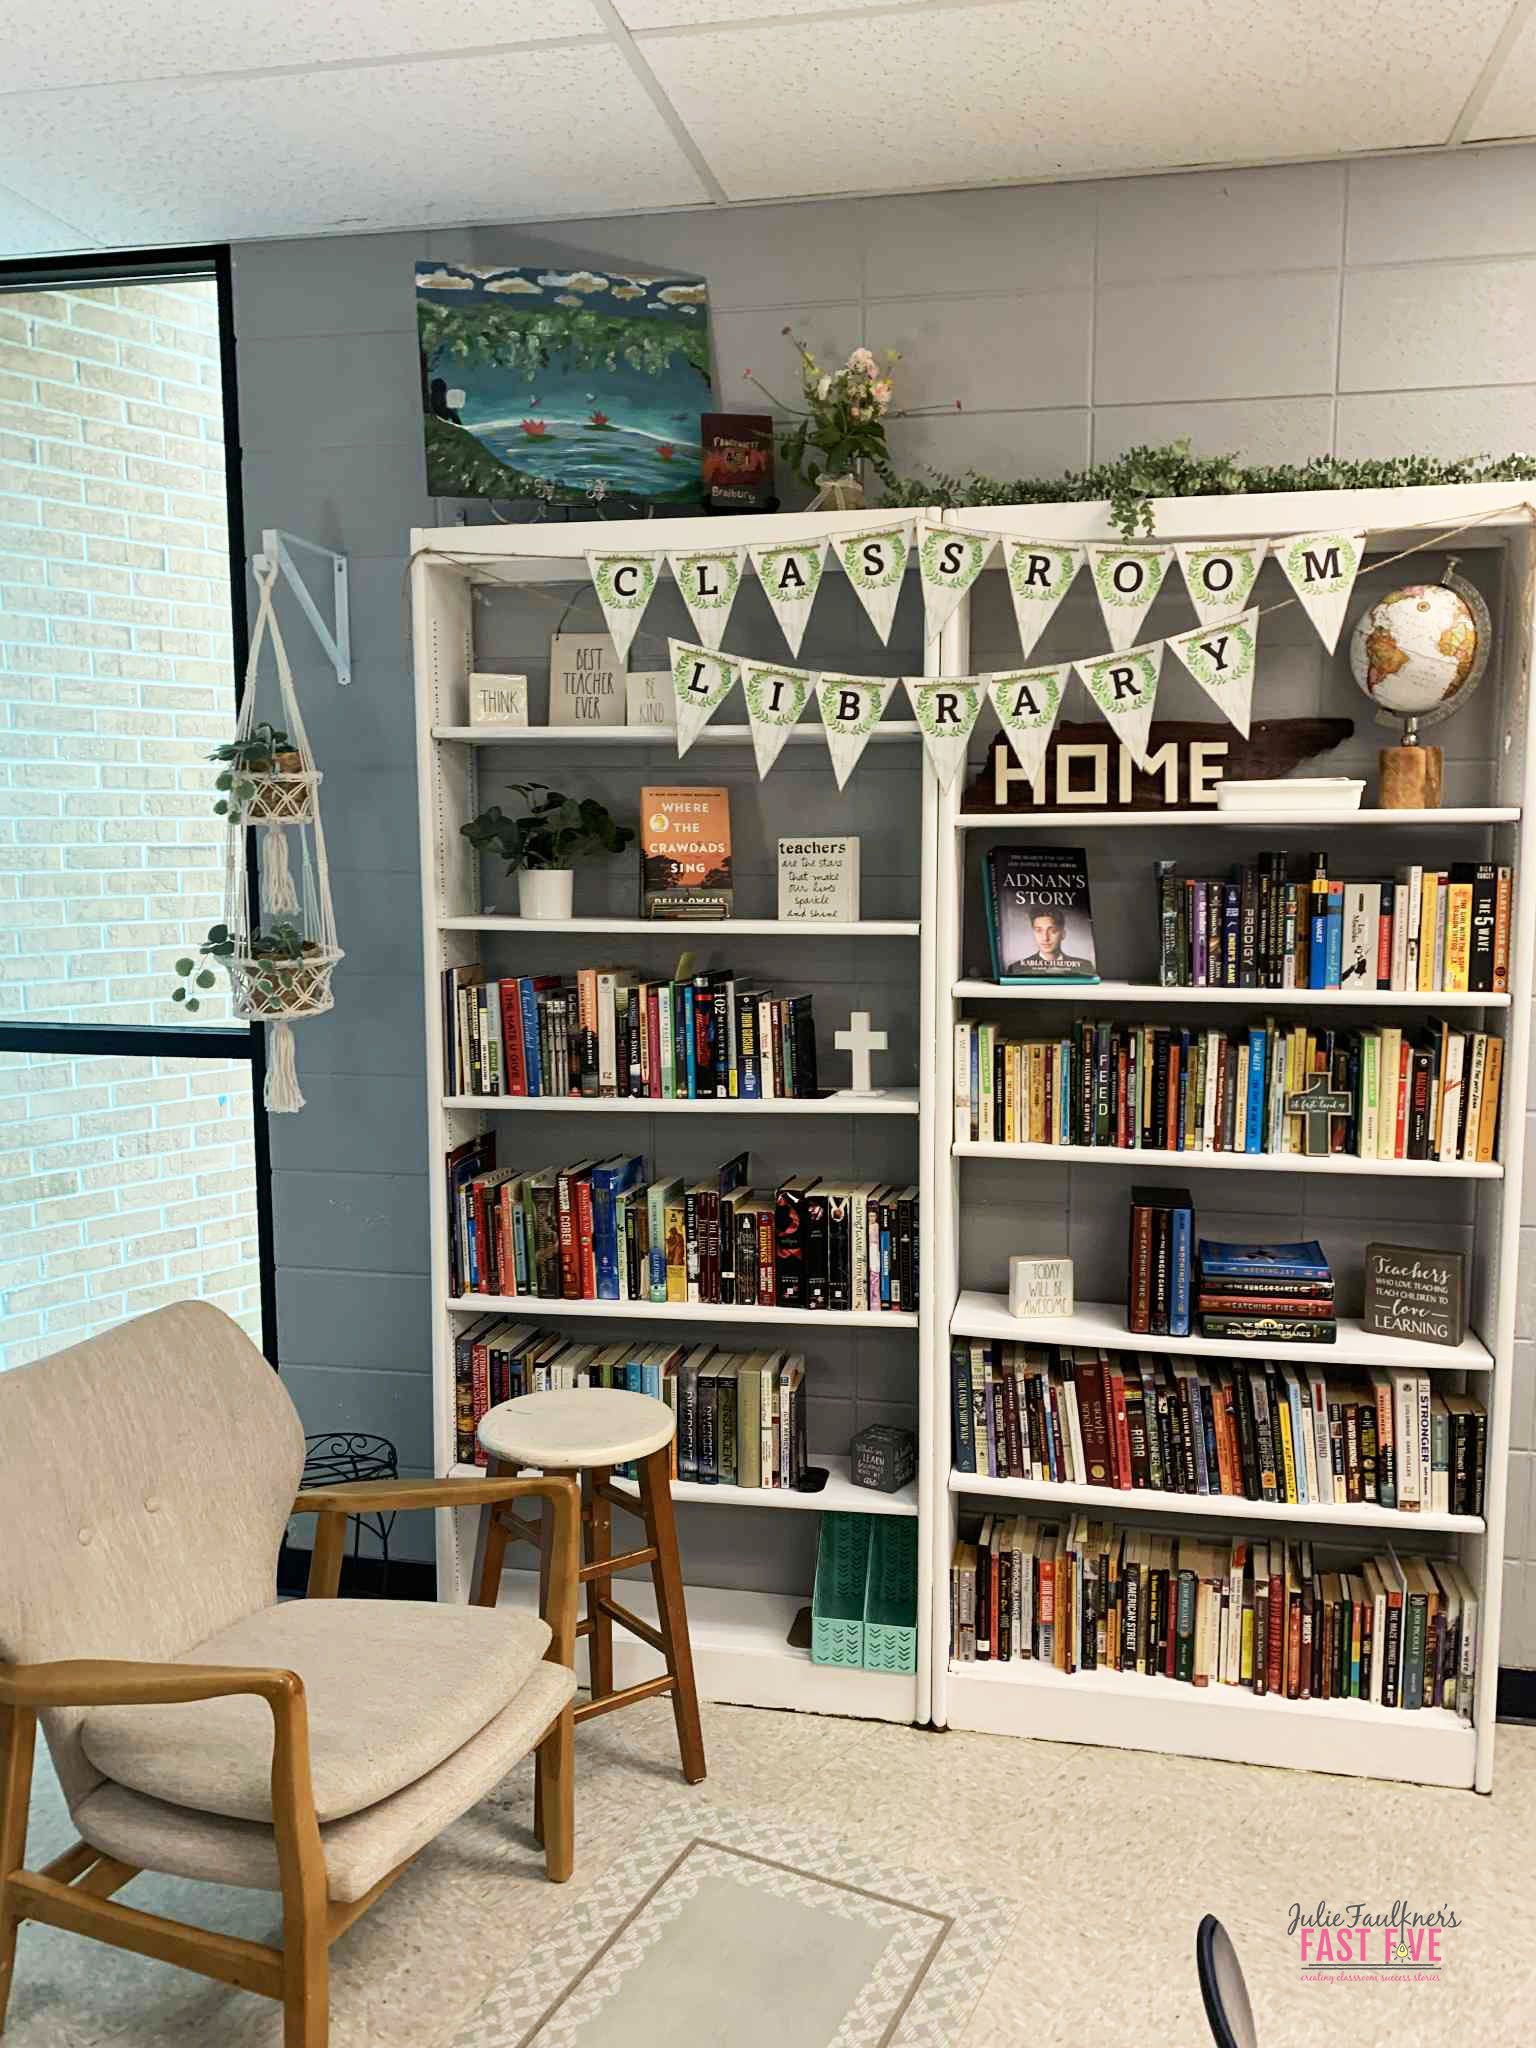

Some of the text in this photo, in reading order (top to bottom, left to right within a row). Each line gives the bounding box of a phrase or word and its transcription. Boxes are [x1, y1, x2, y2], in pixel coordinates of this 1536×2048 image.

[576, 648, 602, 670] BEST
[563, 672, 615, 695] TEACHER
[480, 689, 519, 714] THINK
[575, 697, 601, 719] EVER
[640, 702, 664, 723] KIND
[995, 742, 1229, 805] HOME
[662, 803, 709, 813] WHERE
[673, 823, 700, 833] THE
[649, 843, 725, 854] CRAWDADS
[779, 842, 846, 854] teachers
[670, 863, 704, 873] SING
[1003, 873, 1086, 888] ADNAN'S
[1015, 891, 1076, 905] STORY
[1477, 898, 1491, 952] THE WAVE
[1243, 908, 1254, 966] PRODIGY
[714, 992, 726, 1015] 102
[505, 992, 520, 1079] THE HATE U GIVE
[631, 1039, 639, 1064] SHACK
[1098, 1054, 1109, 1116] FEED
[1415, 1072, 1427, 1105] MALCOLM
[560, 1215, 572, 1246] COBEN
[708, 1220, 718, 1256] THE ILIAD
[1372, 1255, 1453, 1285] Teachers
[1376, 1278, 1448, 1294] WHO LOVE TEACHING
[1376, 1287, 1449, 1304] TEACH CHILDREN TO
[1375, 1314, 1448, 1338] LEARNING
[960, 1410, 969, 1425] SHOP
[1420, 1395, 1430, 1463] STRONGER
[702, 1406, 712, 1468] DIVERGENT
[961, 1426, 969, 1440] WAR
[1317, 1435, 1327, 1458] WIND
[1126, 1582, 1137, 1652] AMERICAN STREET
[1388, 1610, 1398, 1665] THE MAZE RUNNER
